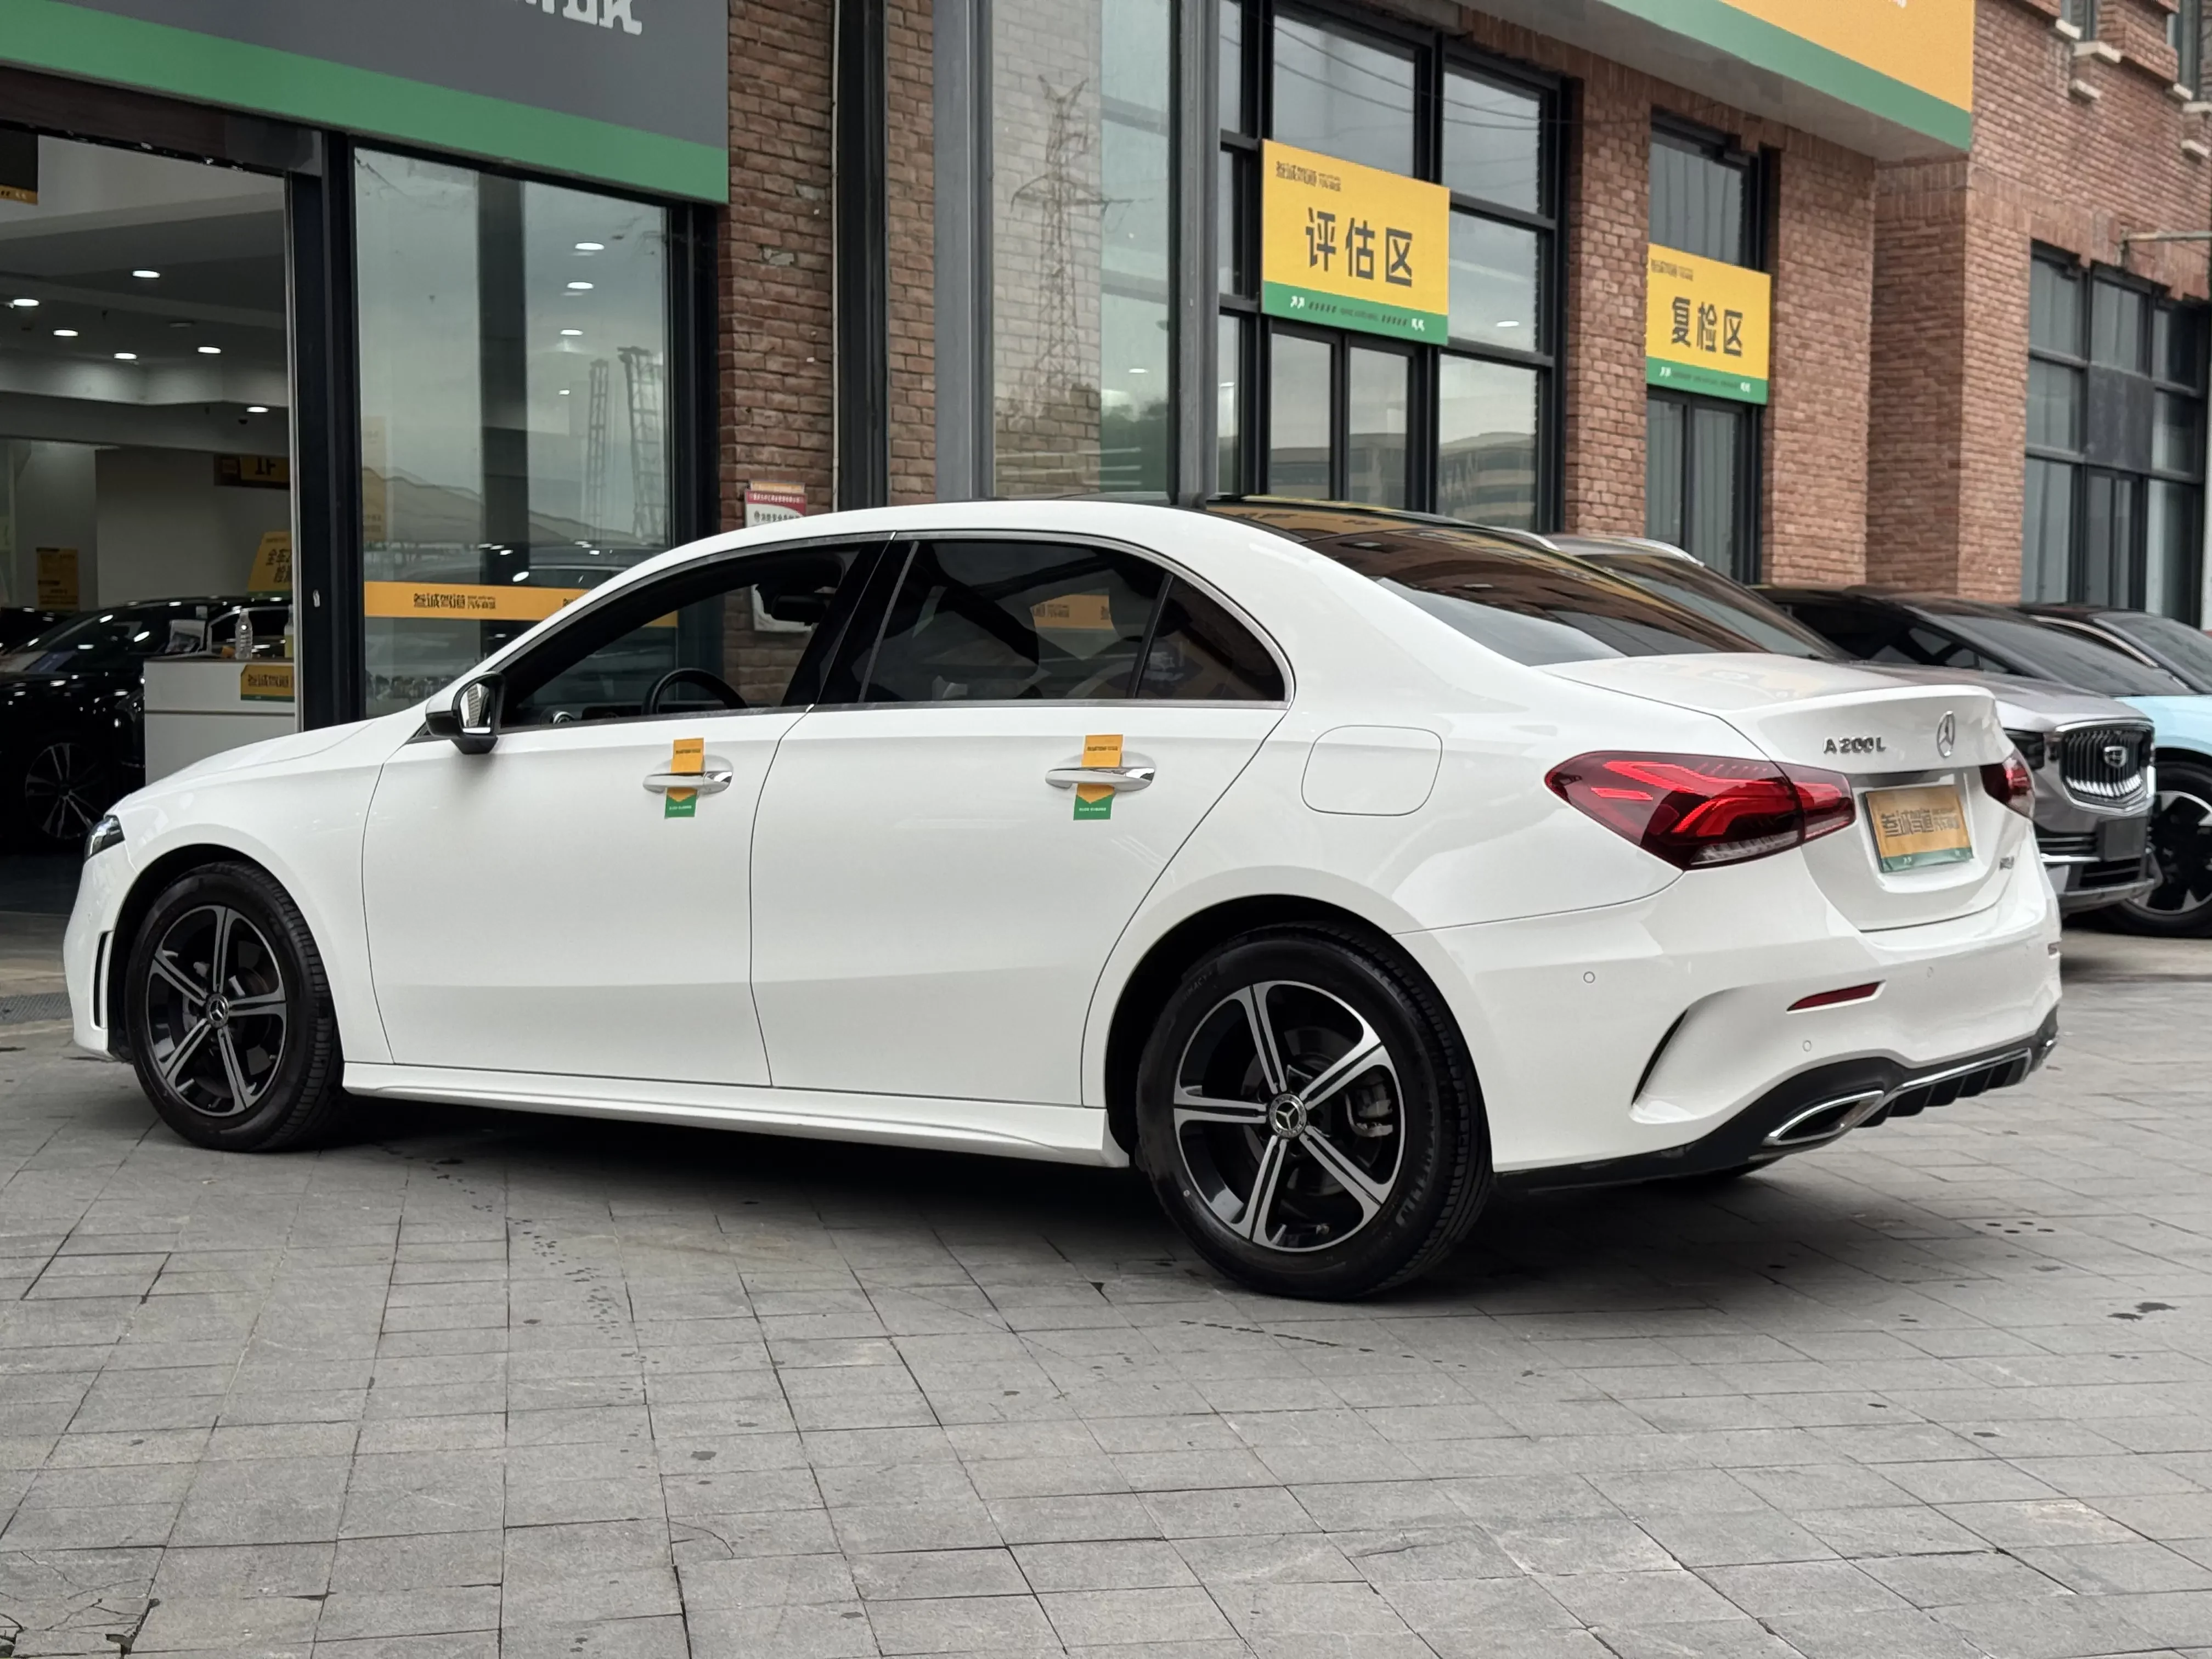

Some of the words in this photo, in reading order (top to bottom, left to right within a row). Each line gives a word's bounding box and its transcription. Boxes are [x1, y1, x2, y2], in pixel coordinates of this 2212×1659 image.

[1306, 207, 1413, 288] 评估区
[1671, 296, 1743, 357] 复检区
